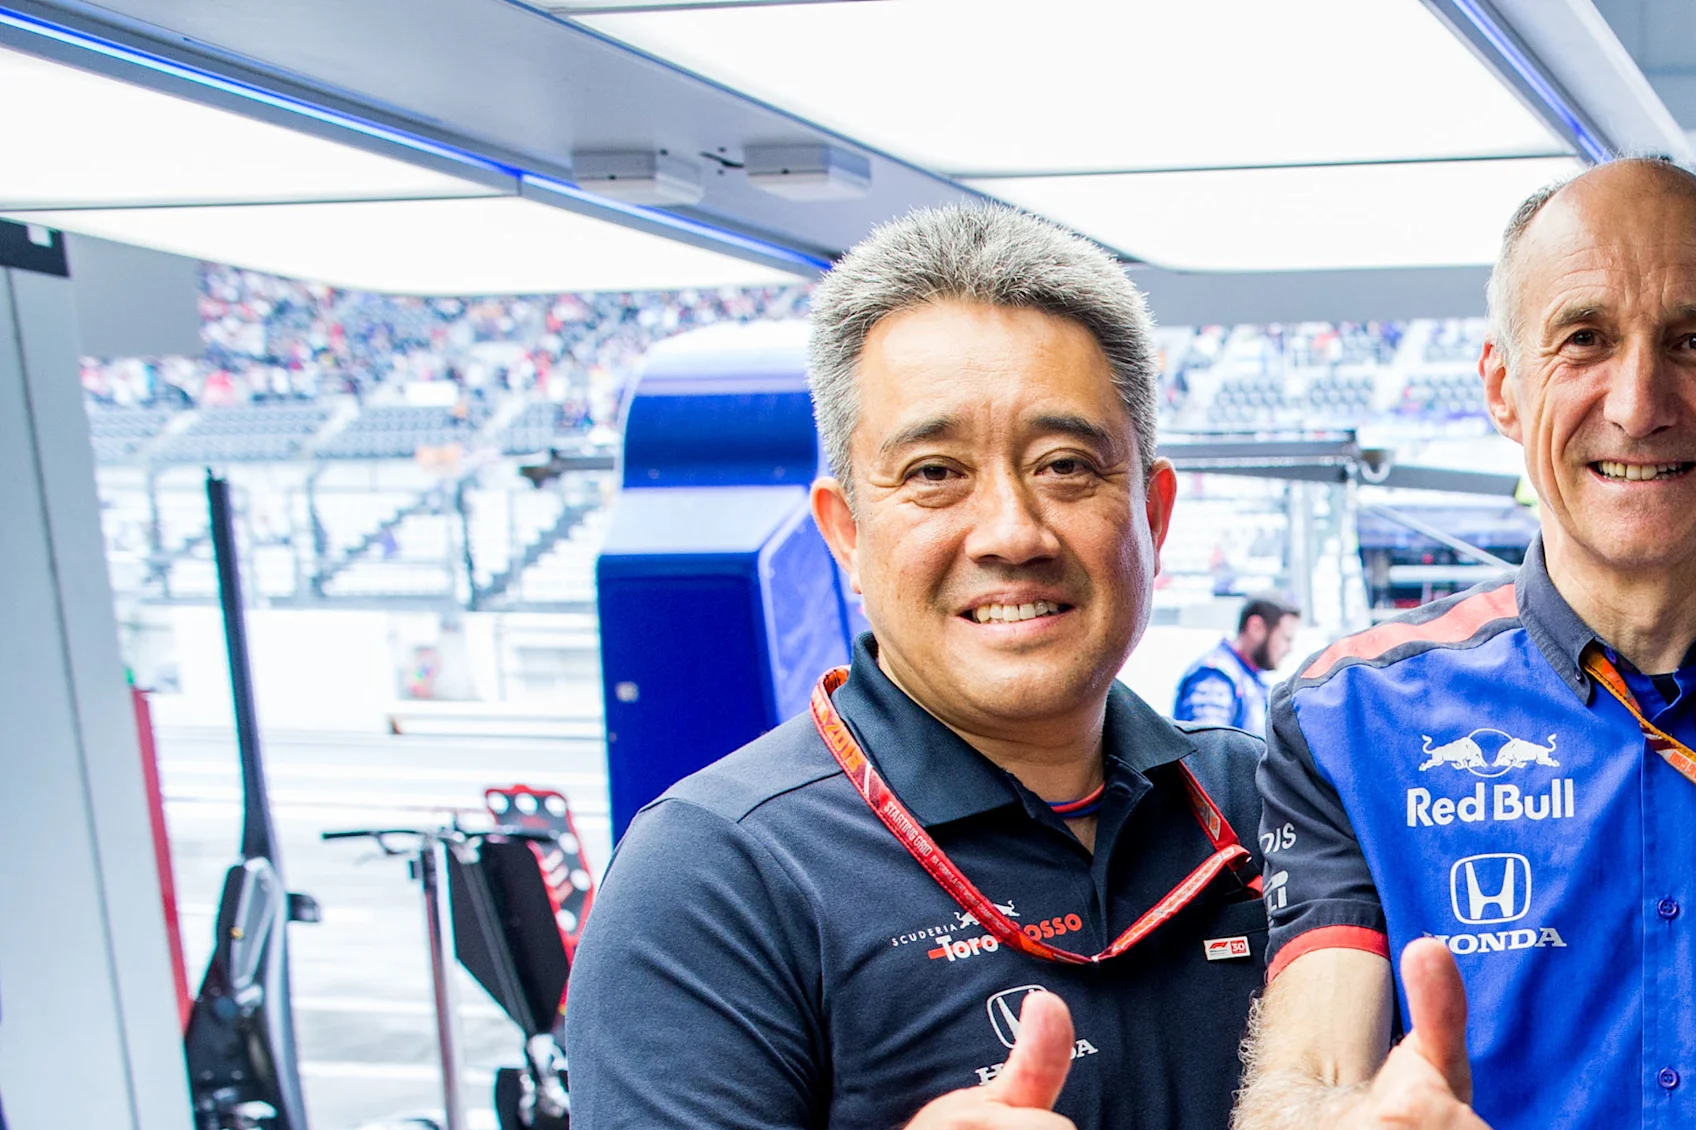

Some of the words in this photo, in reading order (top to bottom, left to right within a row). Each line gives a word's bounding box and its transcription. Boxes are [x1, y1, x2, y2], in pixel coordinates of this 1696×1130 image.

[1667, 751, 1691, 772] GRID
[1407, 782, 1485, 827] Red
[1494, 779, 1574, 820] Bull
[882, 799, 919, 841] STARTING
[912, 835, 934, 858] GRID
[891, 923, 957, 947] SCUDERIA
[936, 934, 999, 961] Toro
[1232, 942, 1245, 951] 30
